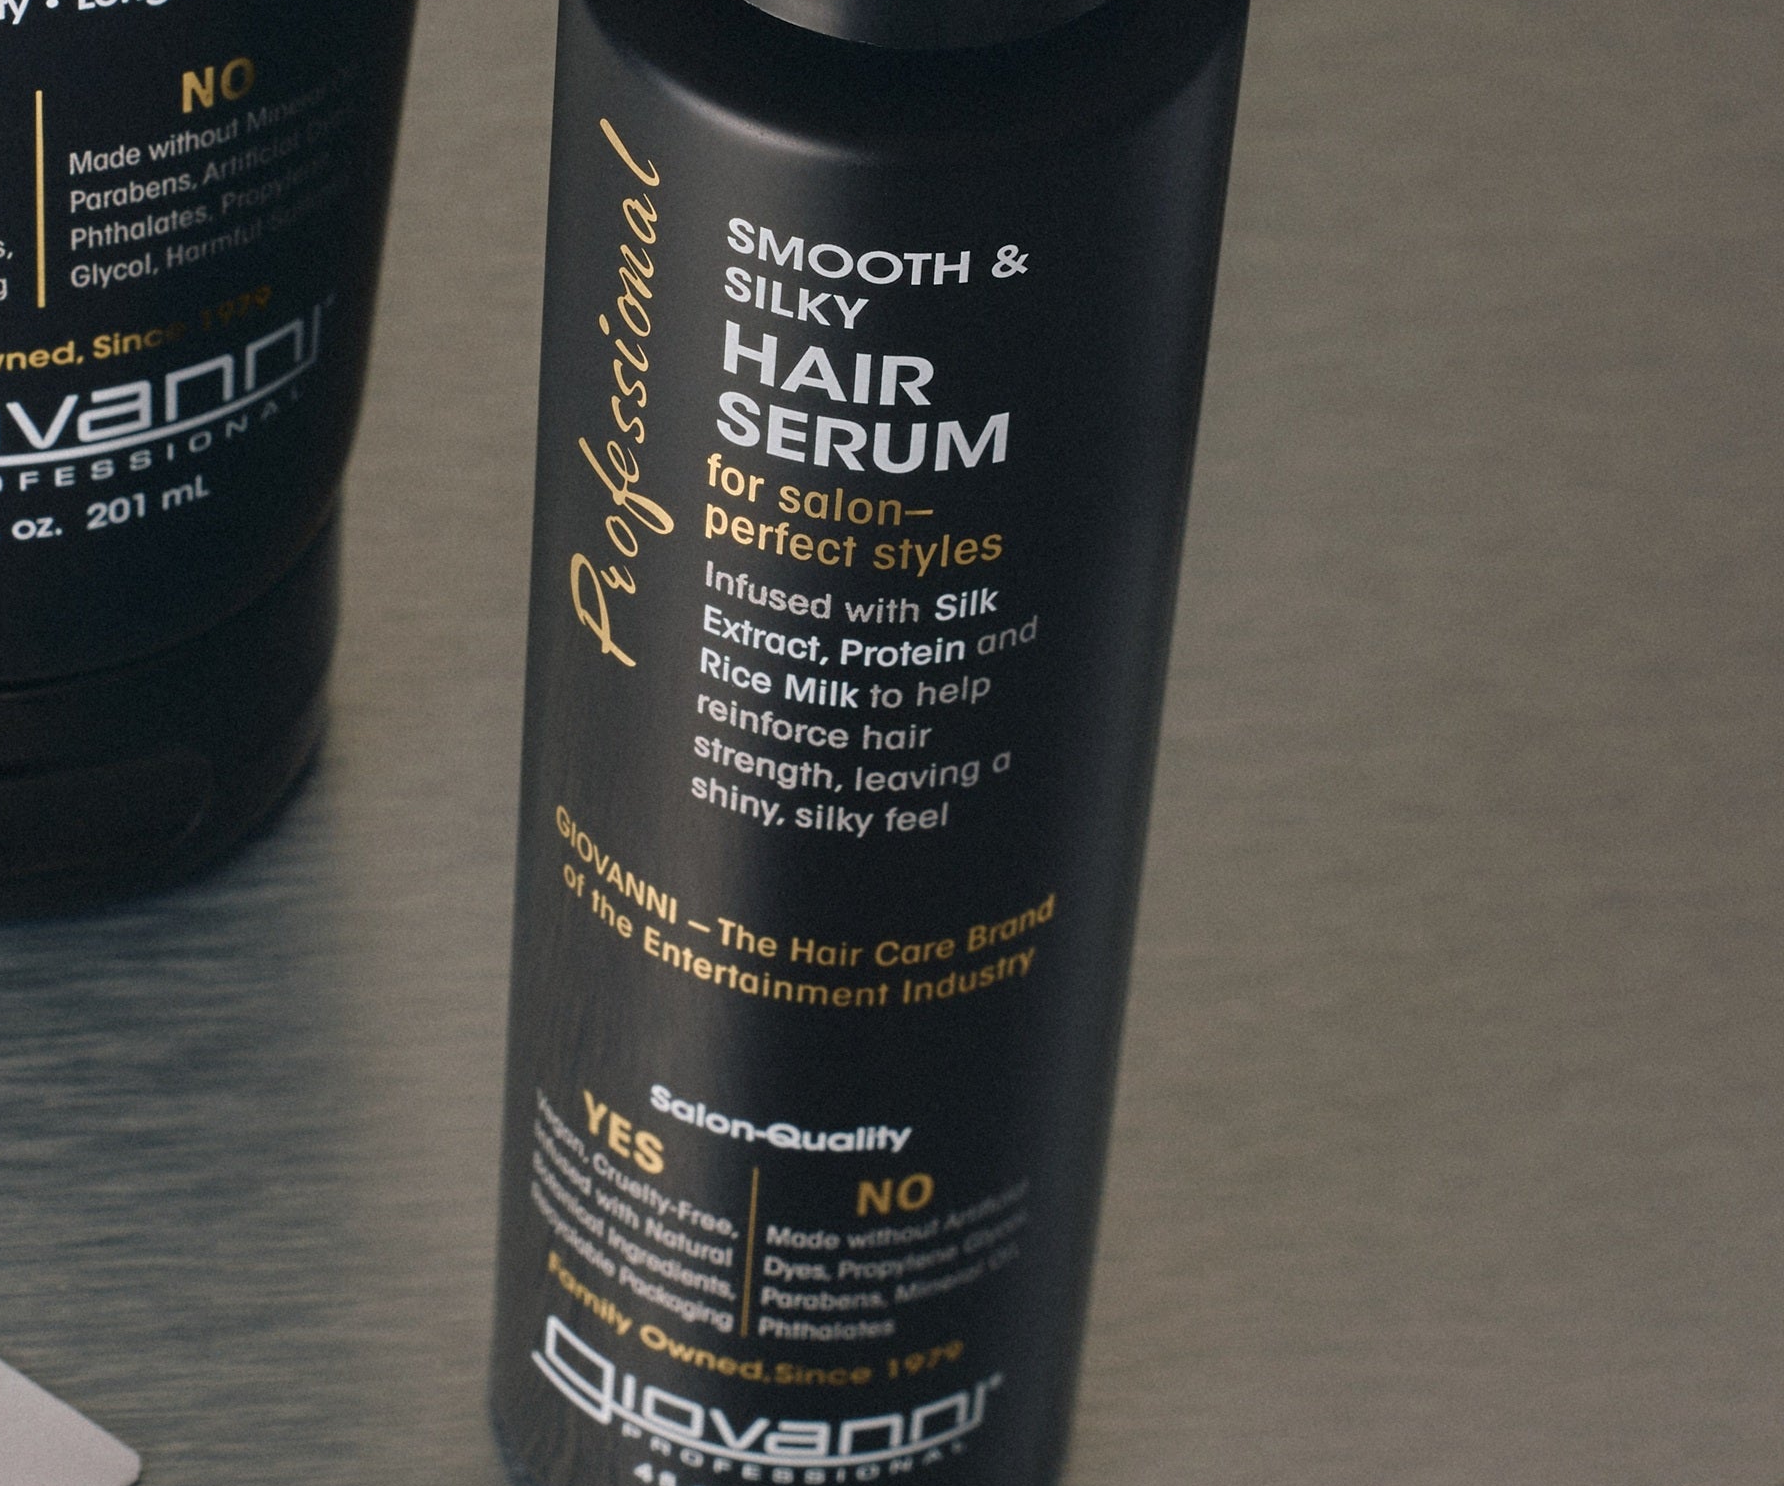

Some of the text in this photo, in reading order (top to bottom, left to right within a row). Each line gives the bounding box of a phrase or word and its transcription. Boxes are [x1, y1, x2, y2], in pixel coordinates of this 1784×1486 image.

[182, 56, 256, 114] NO
[69, 144, 141, 176] Made
[149, 119, 239, 162] without
[70, 172, 197, 213] Parabens,
[70, 206, 213, 251] Phthalates,
[726, 216, 1029, 286] SMOOTH &
[70, 254, 159, 289] Glycol,
[723, 265, 869, 330] SILKY
[92, 322, 186, 359] Since
[722, 318, 934, 406] HAIR
[570, 118, 676, 668] Professional
[715, 390, 1010, 474] SERUM
[11, 516, 63, 541] oz.
[86, 492, 146, 531] 201
[161, 474, 210, 511] mL
[706, 452, 934, 525] for salon–
[704, 502, 1003, 578] perfect styles
[704, 559, 999, 624] Infused with Silk
[702, 603, 1038, 668] Extract, Protein and
[699, 646, 991, 709] Rice Milk to help
[696, 692, 933, 751] reinforce hair
[692, 728, 1012, 793] strength, leaving a
[690, 775, 949, 839] shiny, silky feel
[556, 805, 678, 927] GIOVANNI
[789, 936, 862, 967] Hair
[874, 938, 956, 968] Care
[967, 893, 1056, 953] Brand
[563, 864, 1036, 1007] of the Entertainment Industry
[579, 1090, 665, 1180] YES
[648, 1082, 912, 1153] Salon-Quality
[593, 1153, 739, 1239] Cruelty-Free,
[596, 1188, 640, 1230] with
[646, 1217, 733, 1266] Natural
[856, 1173, 934, 1216] NO
[766, 1224, 840, 1250] Made
[547, 1250, 634, 1336] Family
[774, 1362, 873, 1386] Since
[887, 1338, 964, 1380] 1979
[633, 1461, 653, 1485] 4
